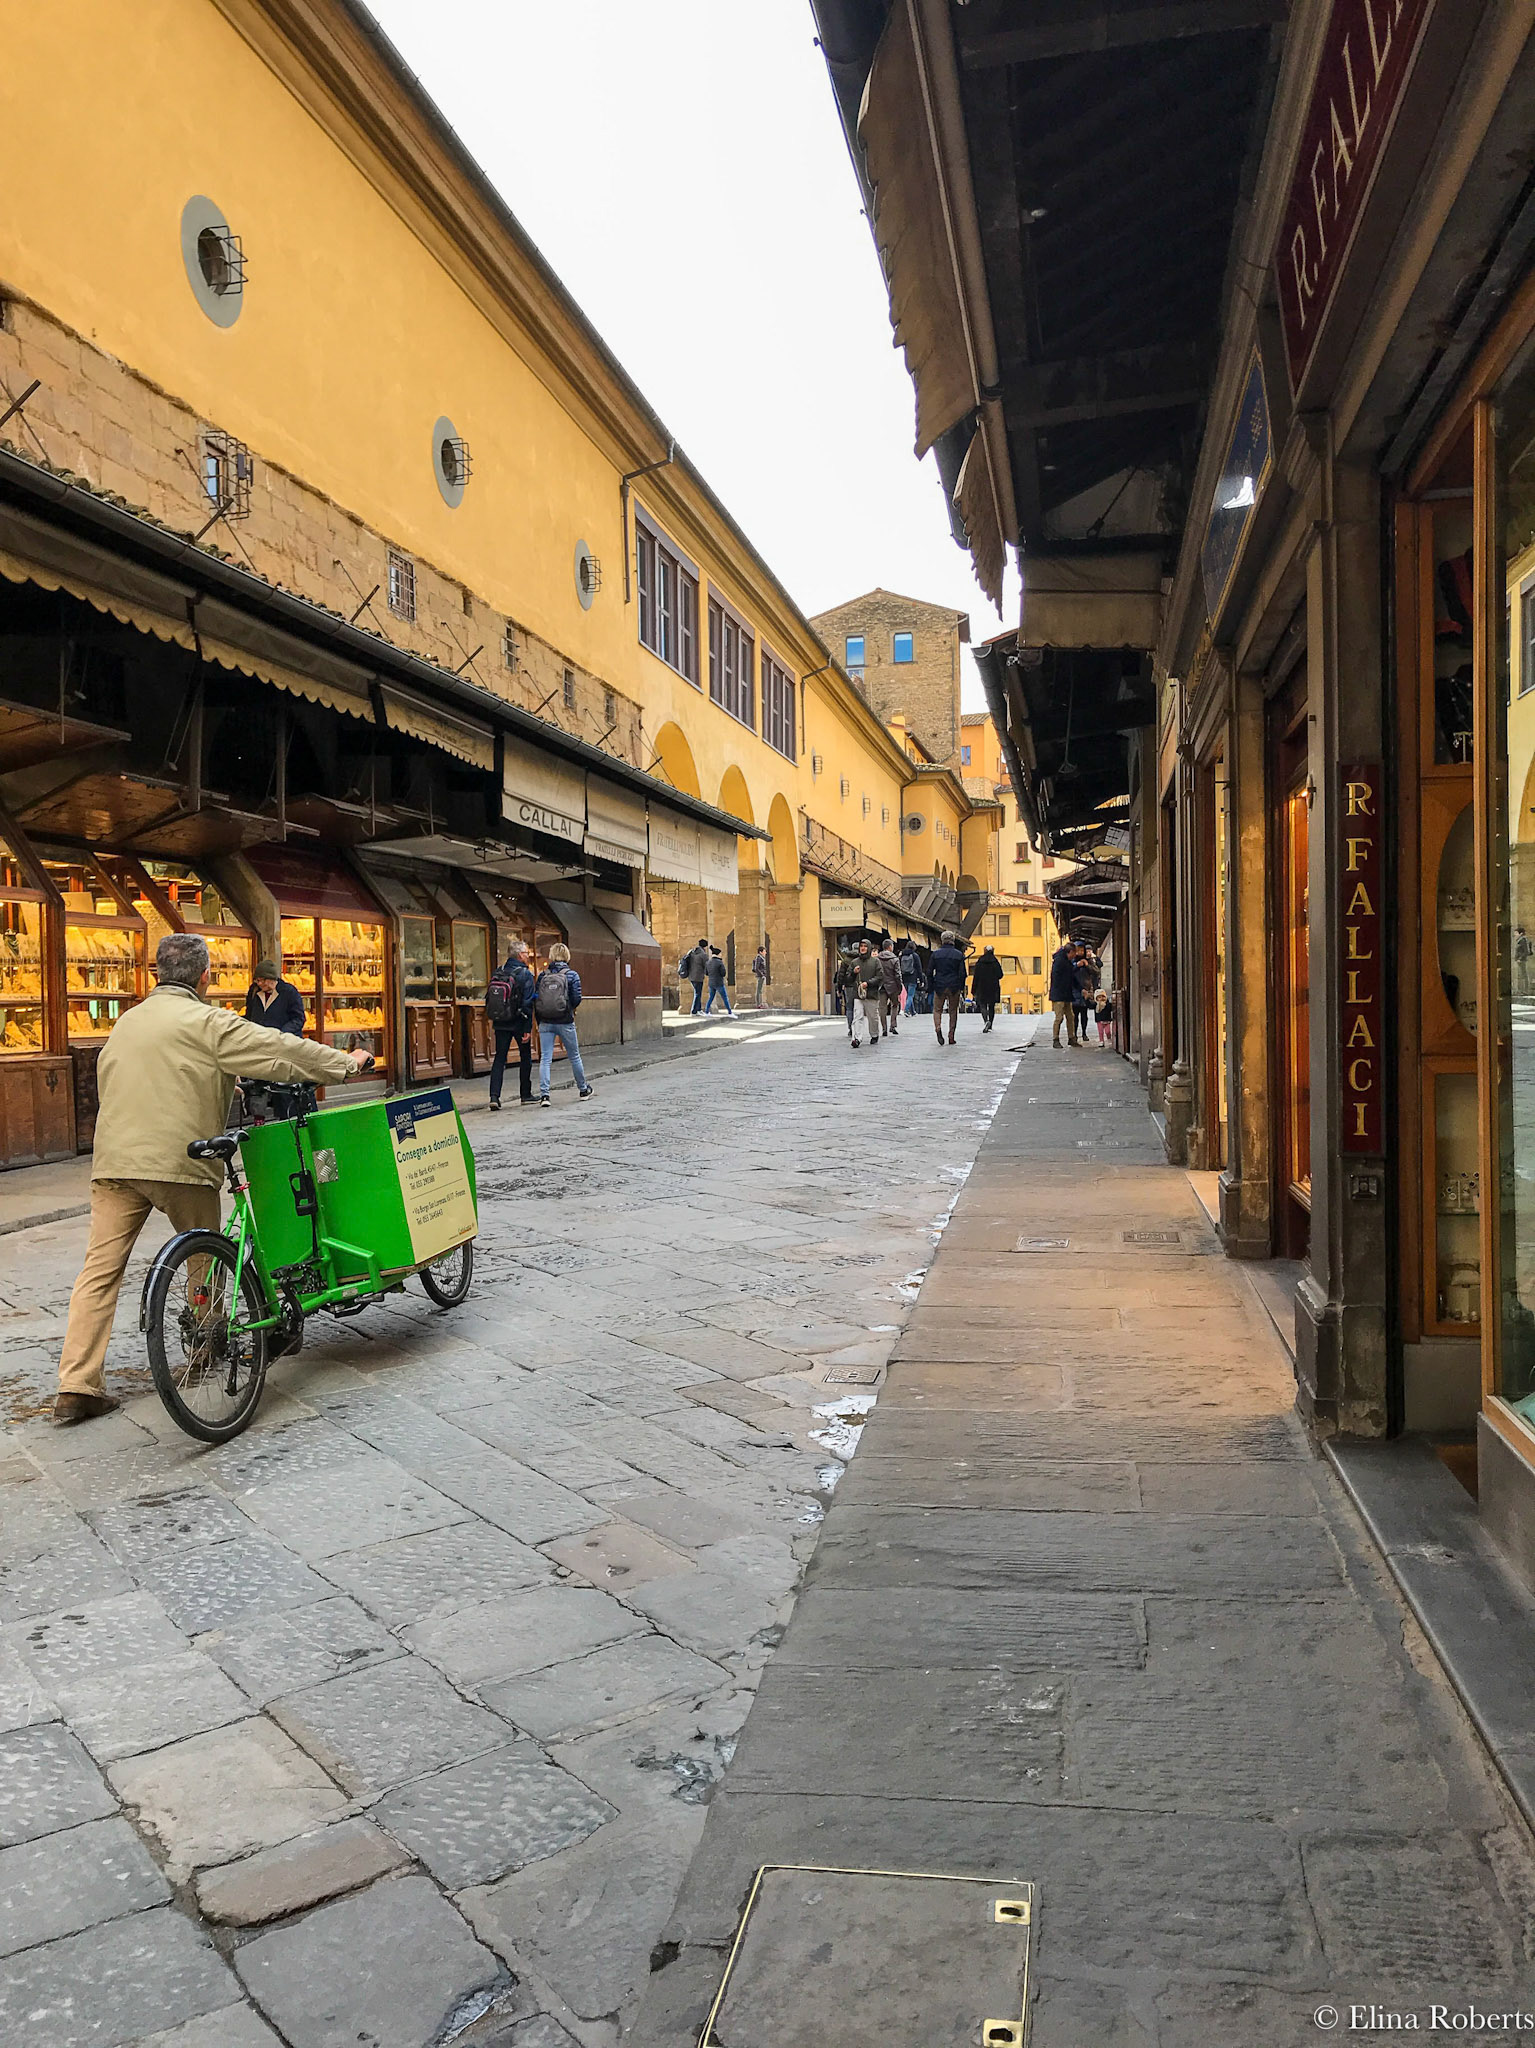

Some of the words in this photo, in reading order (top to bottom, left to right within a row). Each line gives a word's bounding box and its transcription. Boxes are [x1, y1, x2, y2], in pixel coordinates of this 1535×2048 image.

[1310, 0, 1404, 266] FALL
[519, 804, 572, 837] CALLAI
[1345, 837, 1376, 1136] FALLACI
[396, 1145, 428, 1163] Consegne
[428, 1144, 433, 1153] a
[433, 1134, 459, 1151] domicilio
